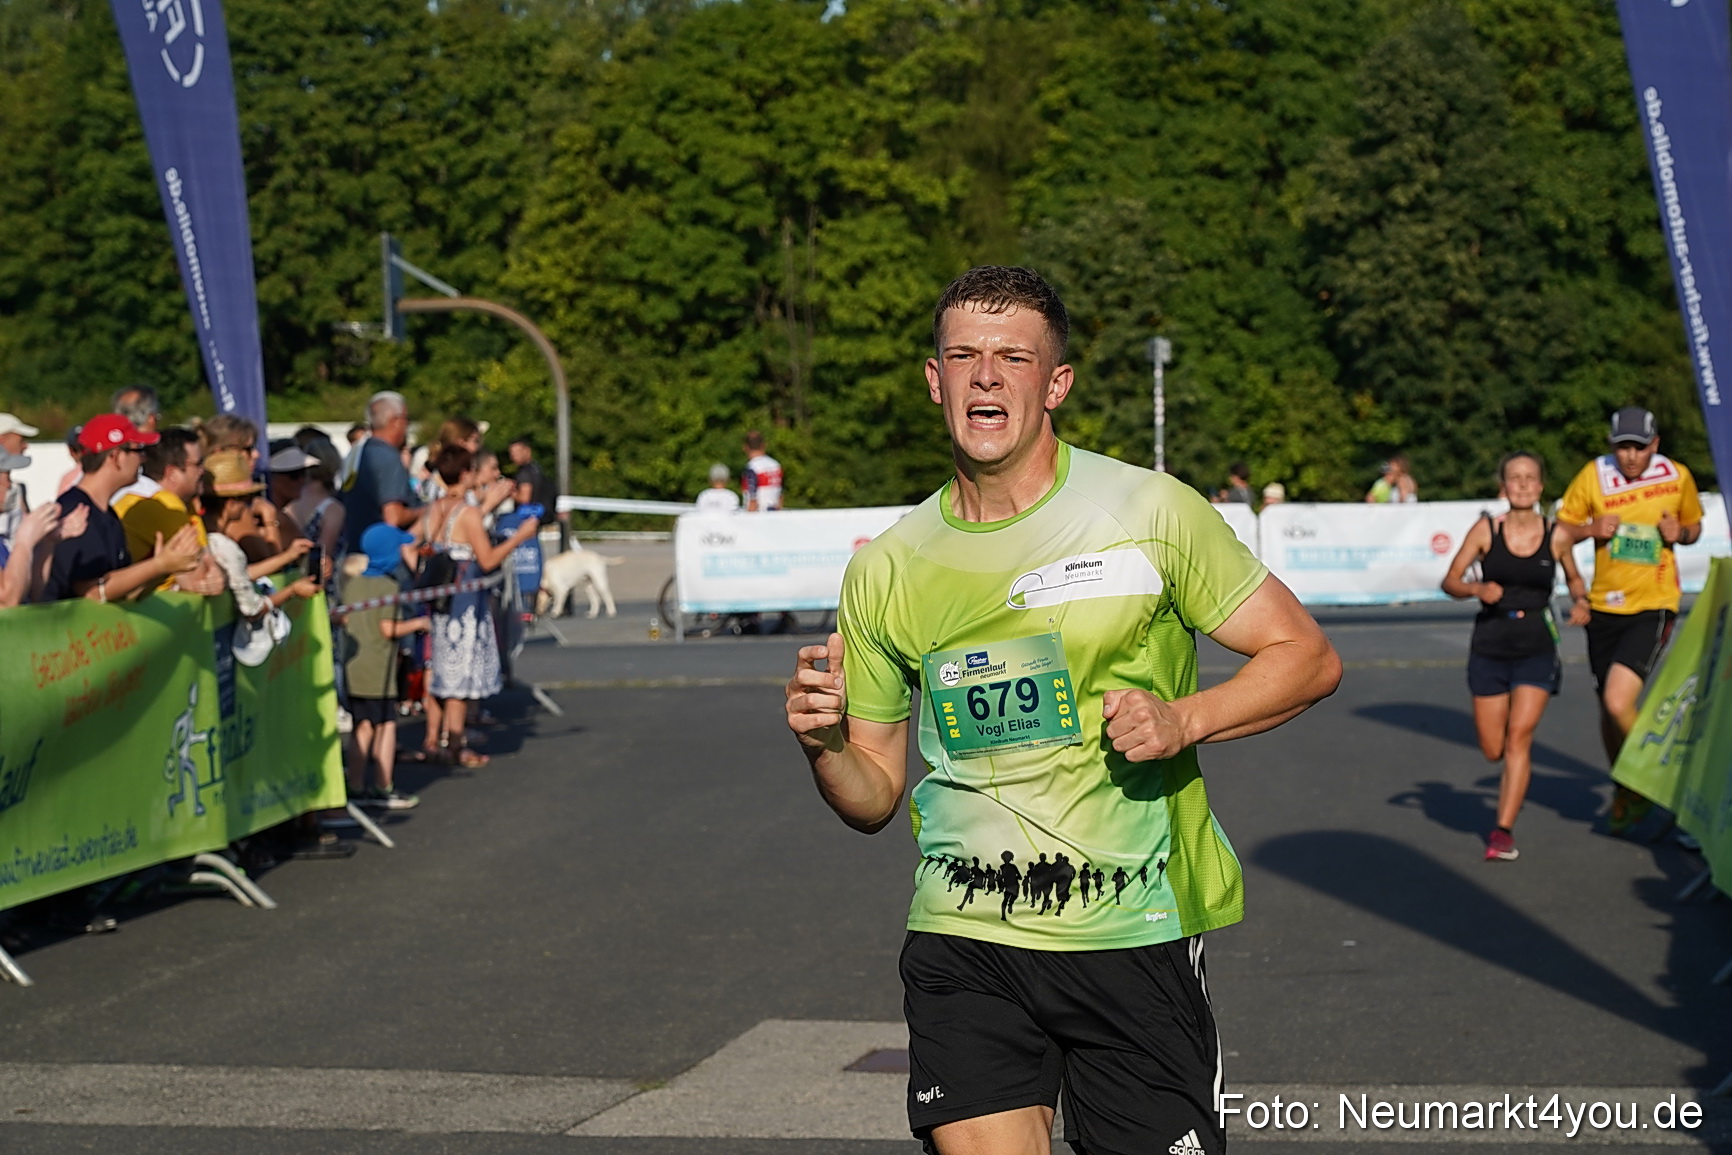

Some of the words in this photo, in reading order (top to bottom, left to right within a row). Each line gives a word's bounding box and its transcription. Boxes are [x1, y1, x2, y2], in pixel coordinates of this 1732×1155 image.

[1064, 559, 1103, 573] Klinikum
[1064, 568, 1103, 581] Neumarkt
[962, 660, 1006, 679] Firmenlauf
[979, 669, 1007, 680] neumarkt
[966, 677, 1040, 721] 679
[1053, 677, 1074, 729] 2022
[941, 701, 961, 739] RUN
[975, 721, 1006, 738] Vogl
[1009, 717, 1041, 733] Elias
[1009, 734, 1031, 744] Neumarkt
[915, 1090, 934, 1104] Vogl
[935, 1086, 945, 1099] E.
[1168, 1143, 1206, 1155] adidas
